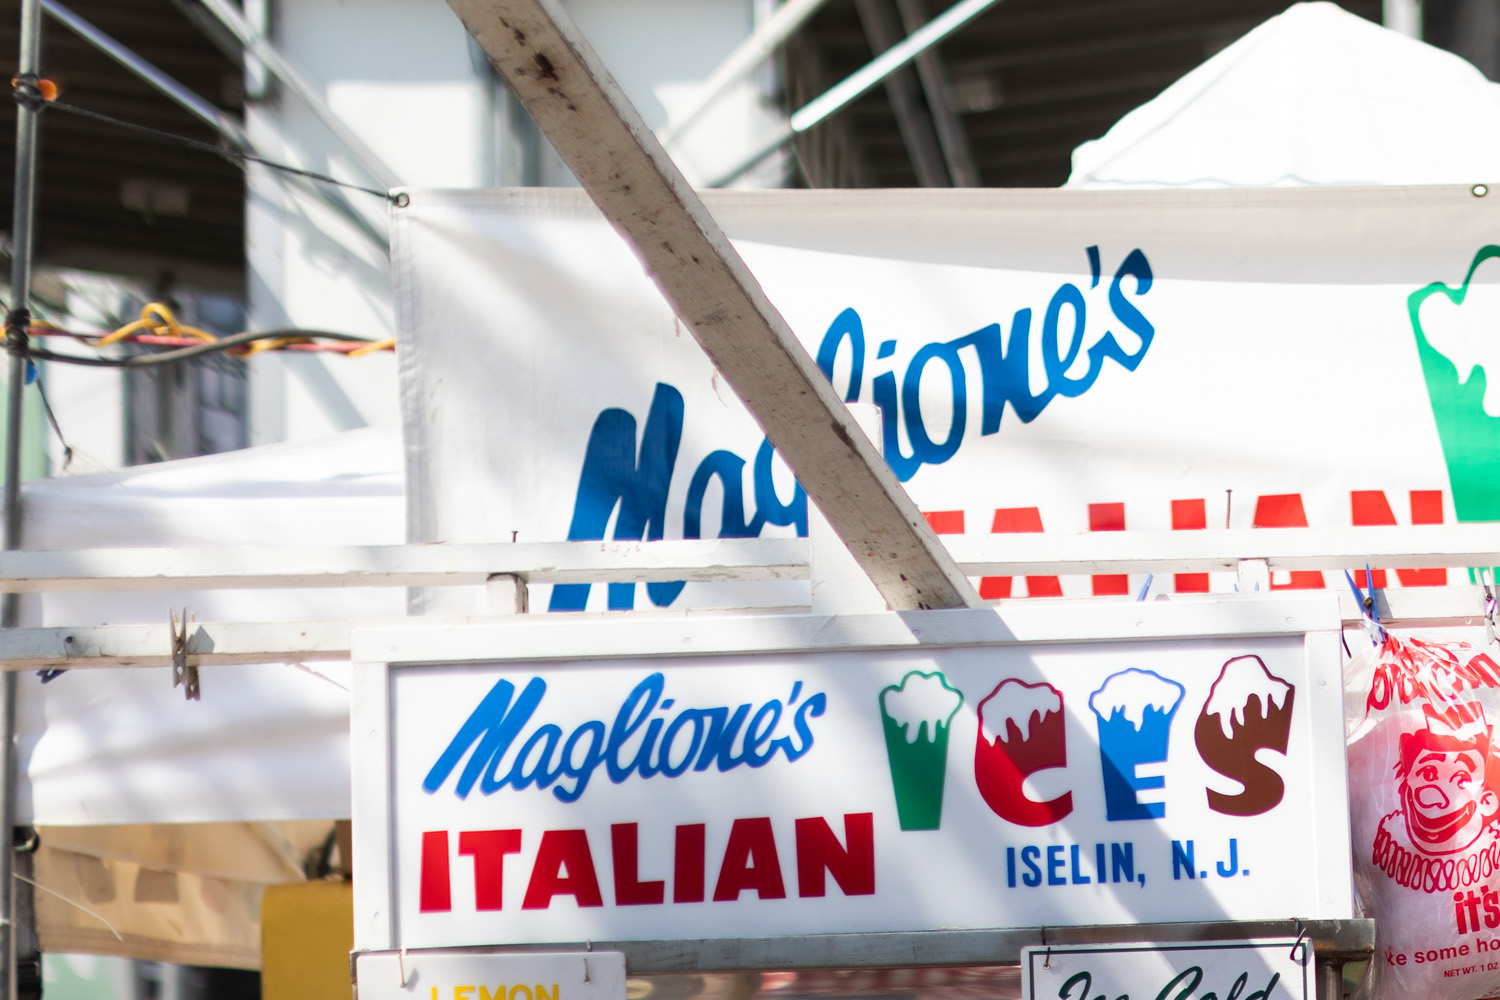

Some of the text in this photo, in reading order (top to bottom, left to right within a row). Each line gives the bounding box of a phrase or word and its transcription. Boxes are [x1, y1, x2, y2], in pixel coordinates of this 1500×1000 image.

[422, 672, 827, 803] Maglione's
[877, 654, 1297, 832] ICES
[418, 812, 876, 914] ITALIAN
[1005, 838, 1251, 889] ISELIN, N.J.
[1453, 884, 1500, 936] it's
[1413, 943, 1470, 965] some
[1443, 968, 1461, 979] NET
[1463, 965, 1478, 976] WT.
[1480, 964, 1485, 973] 1
[1487, 962, 1499, 972] OZ
